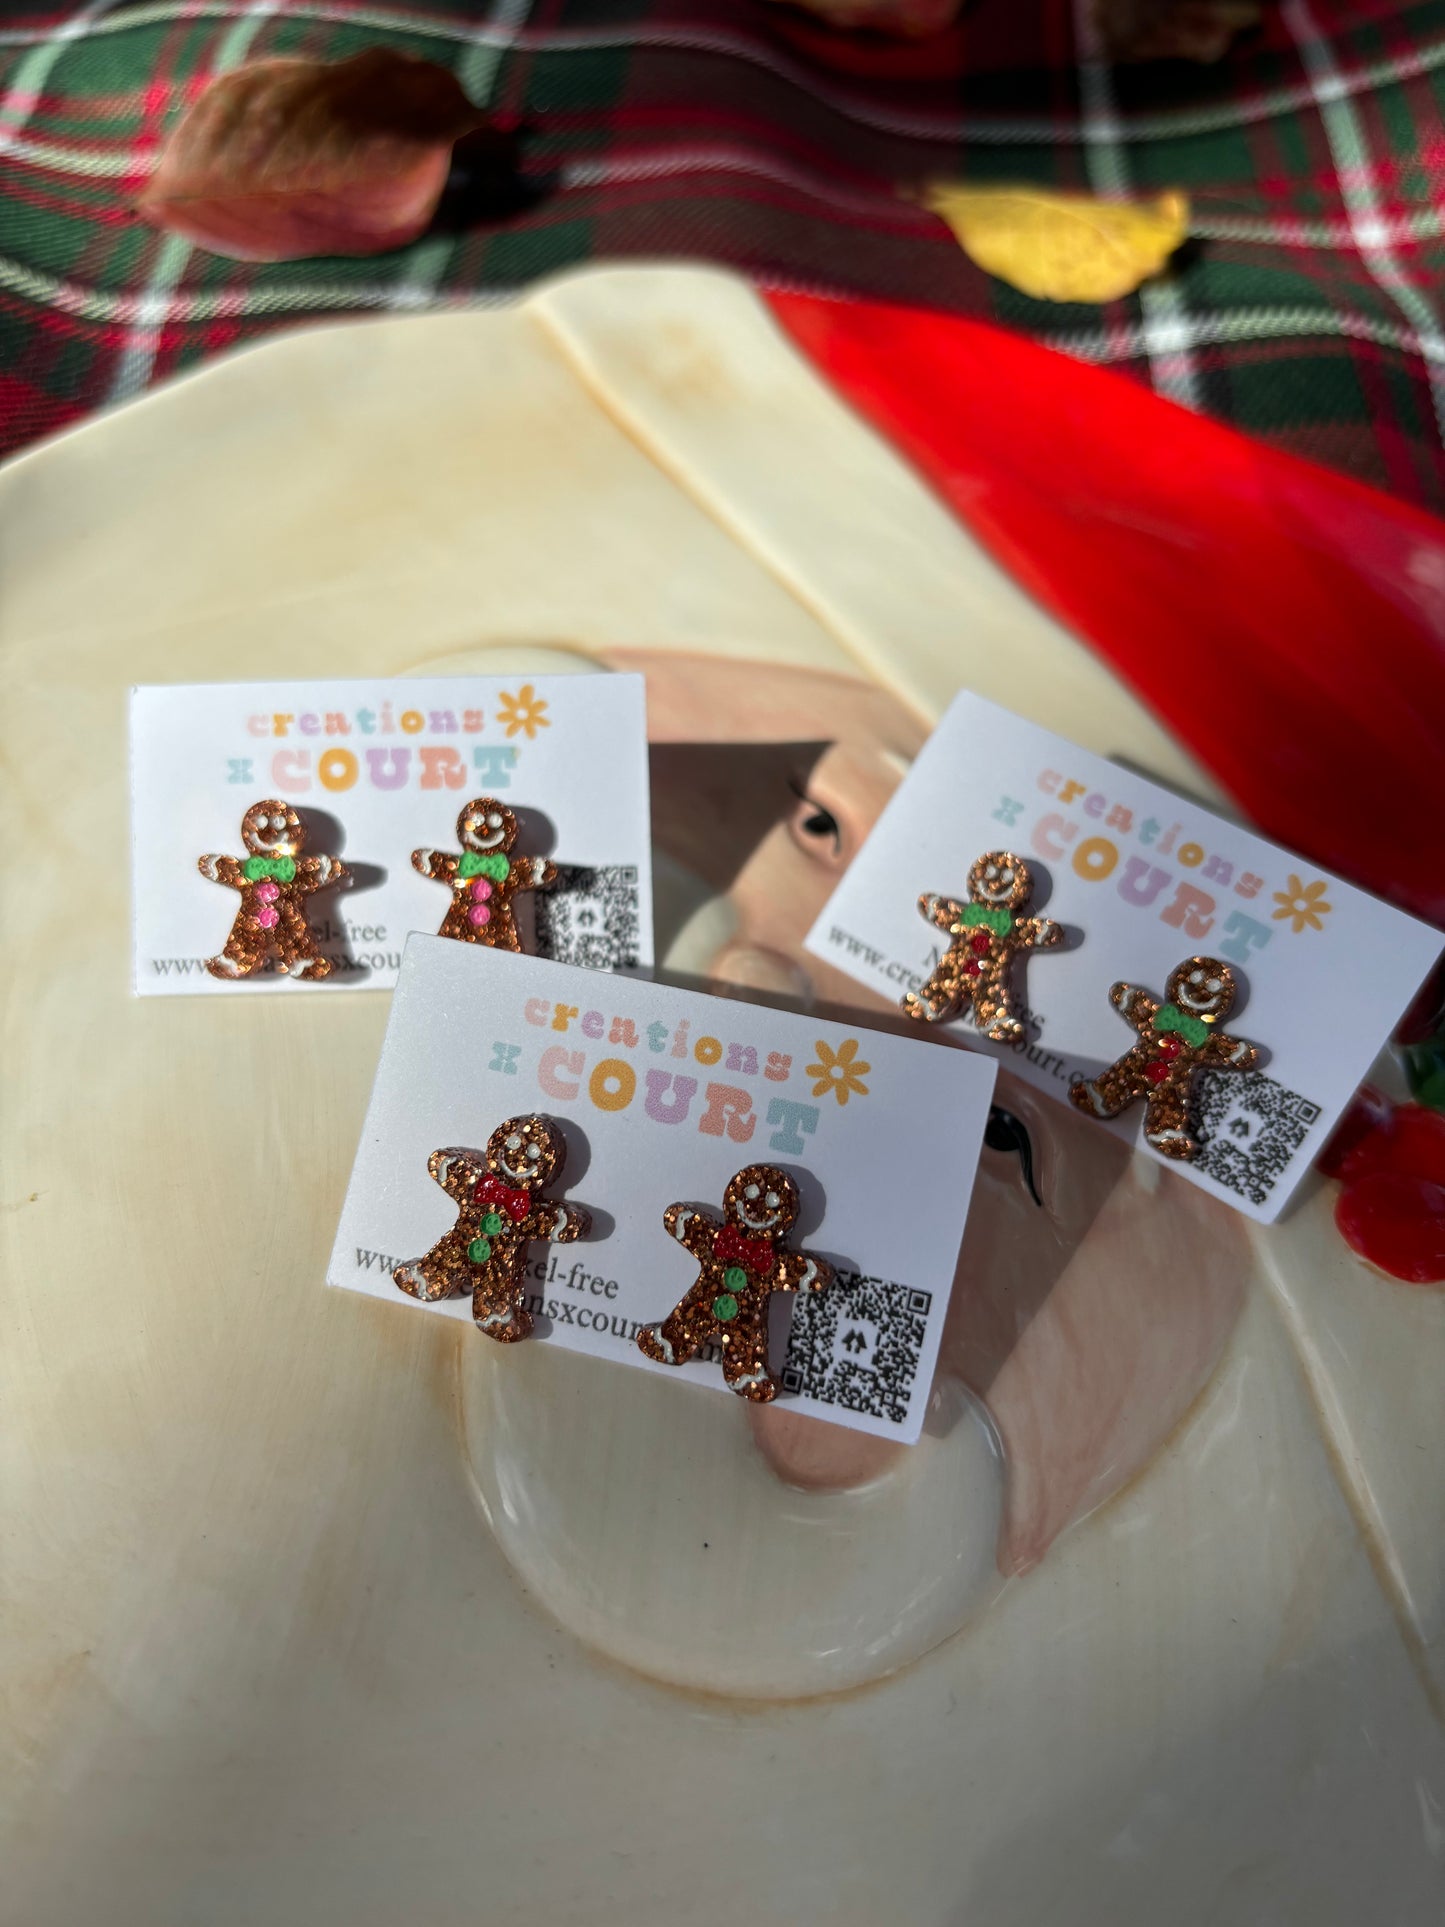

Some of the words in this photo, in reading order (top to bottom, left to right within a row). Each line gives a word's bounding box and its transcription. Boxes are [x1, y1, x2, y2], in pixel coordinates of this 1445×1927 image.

[247, 700, 485, 738] creations
[270, 744, 518, 792] COURT
[1035, 768, 1267, 899] creations
[1030, 813, 1273, 962] COURT
[525, 997, 792, 1082] creations
[537, 1044, 820, 1157] COURT
